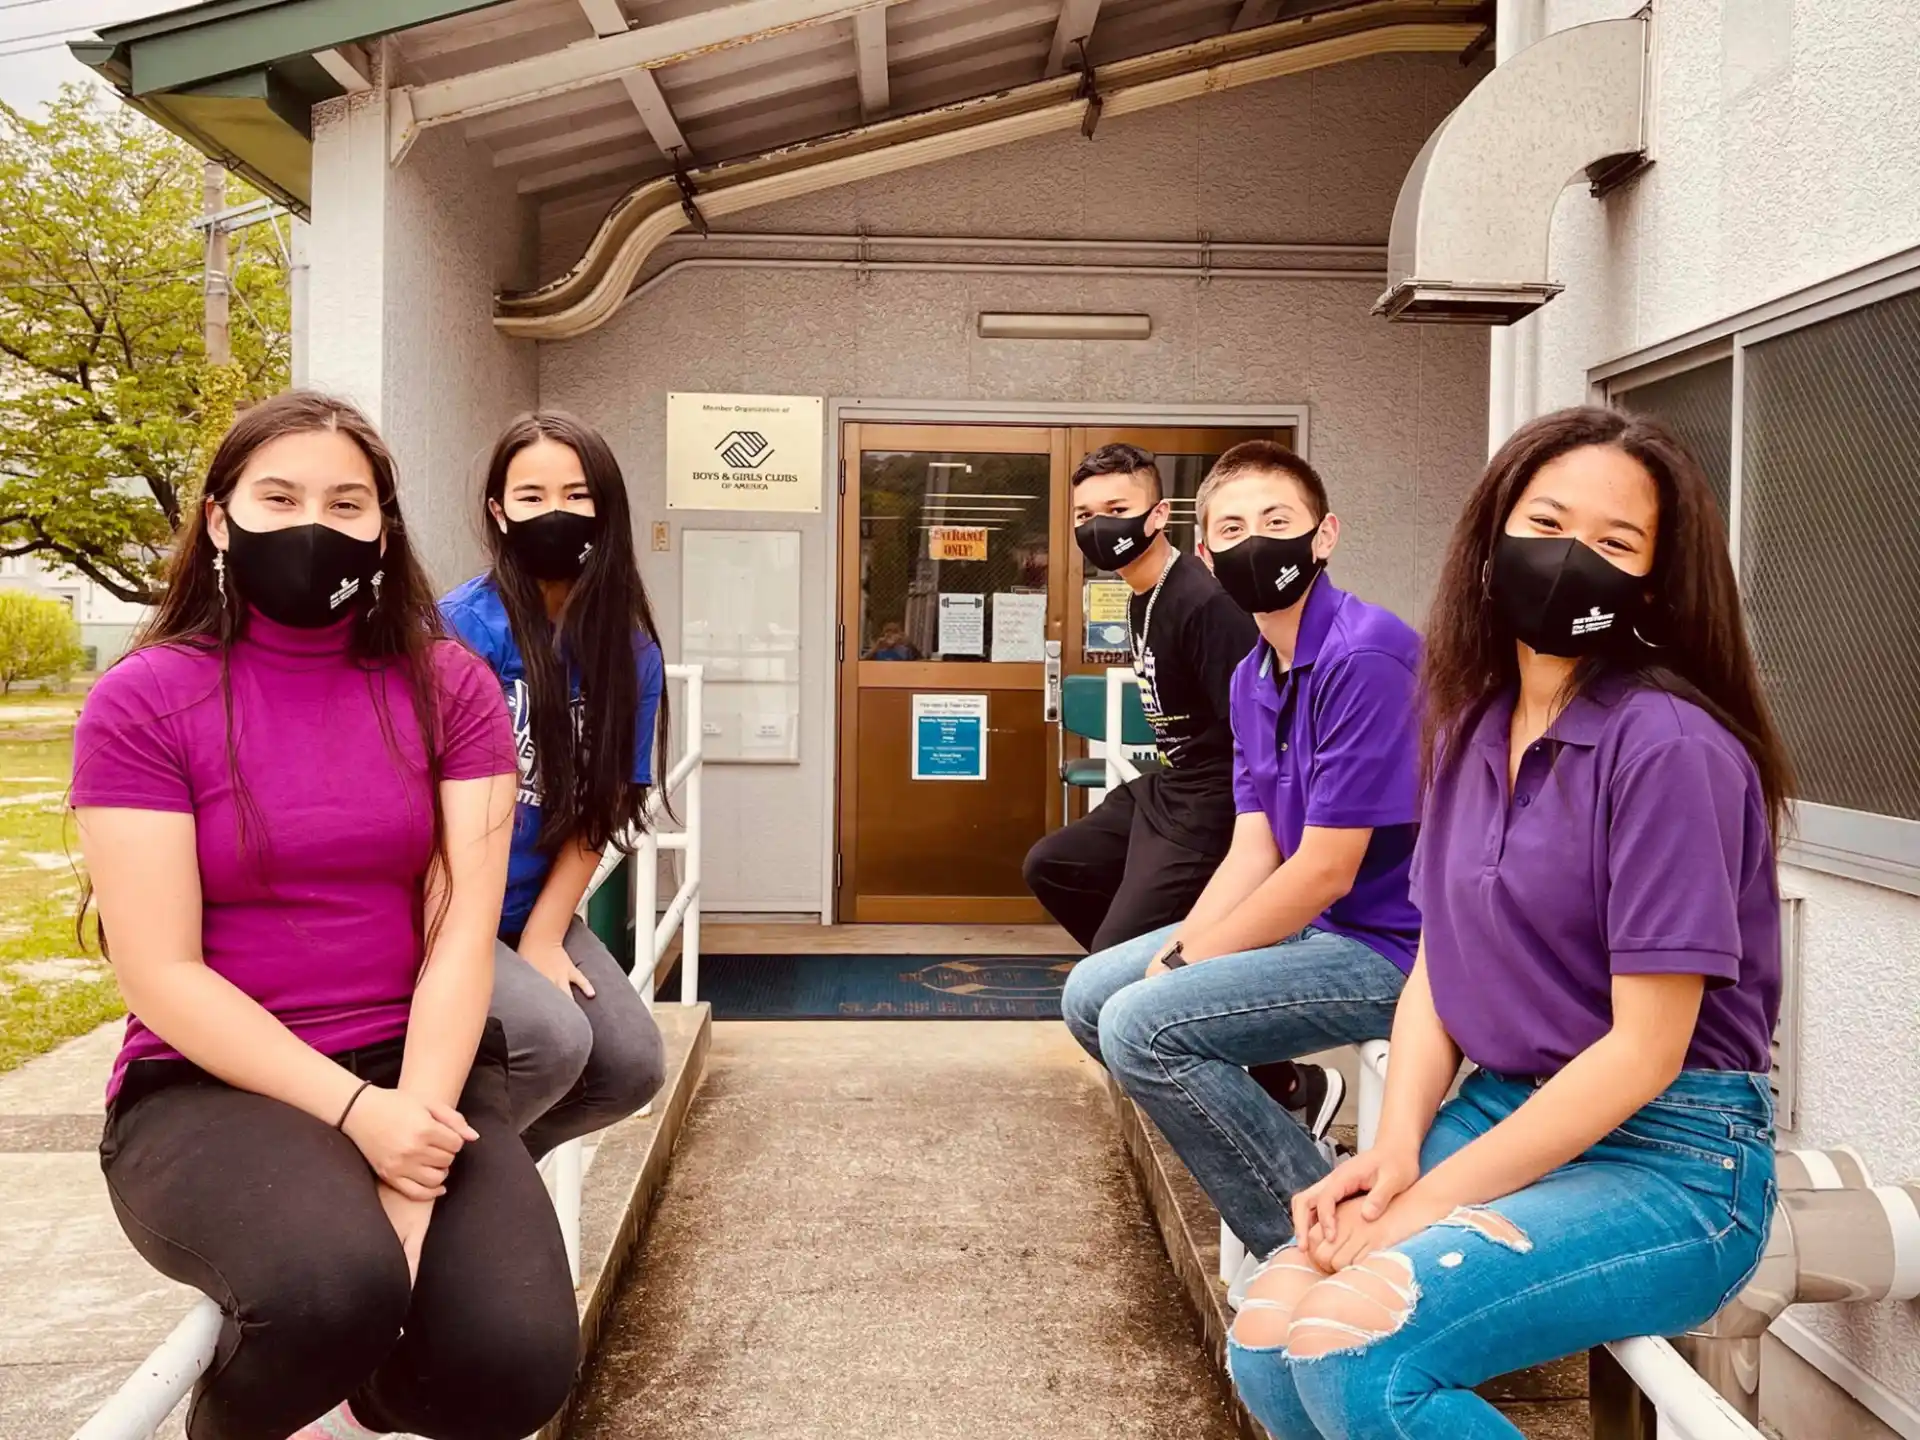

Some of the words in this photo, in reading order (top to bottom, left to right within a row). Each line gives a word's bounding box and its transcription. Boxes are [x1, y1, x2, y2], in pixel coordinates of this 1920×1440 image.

[702, 404, 733, 412] Member
[692, 472, 719, 480] BOYS
[732, 473, 762, 481] GIRLS
[765, 473, 798, 482] CLUBS
[932, 528, 985, 541] ENTRANCE
